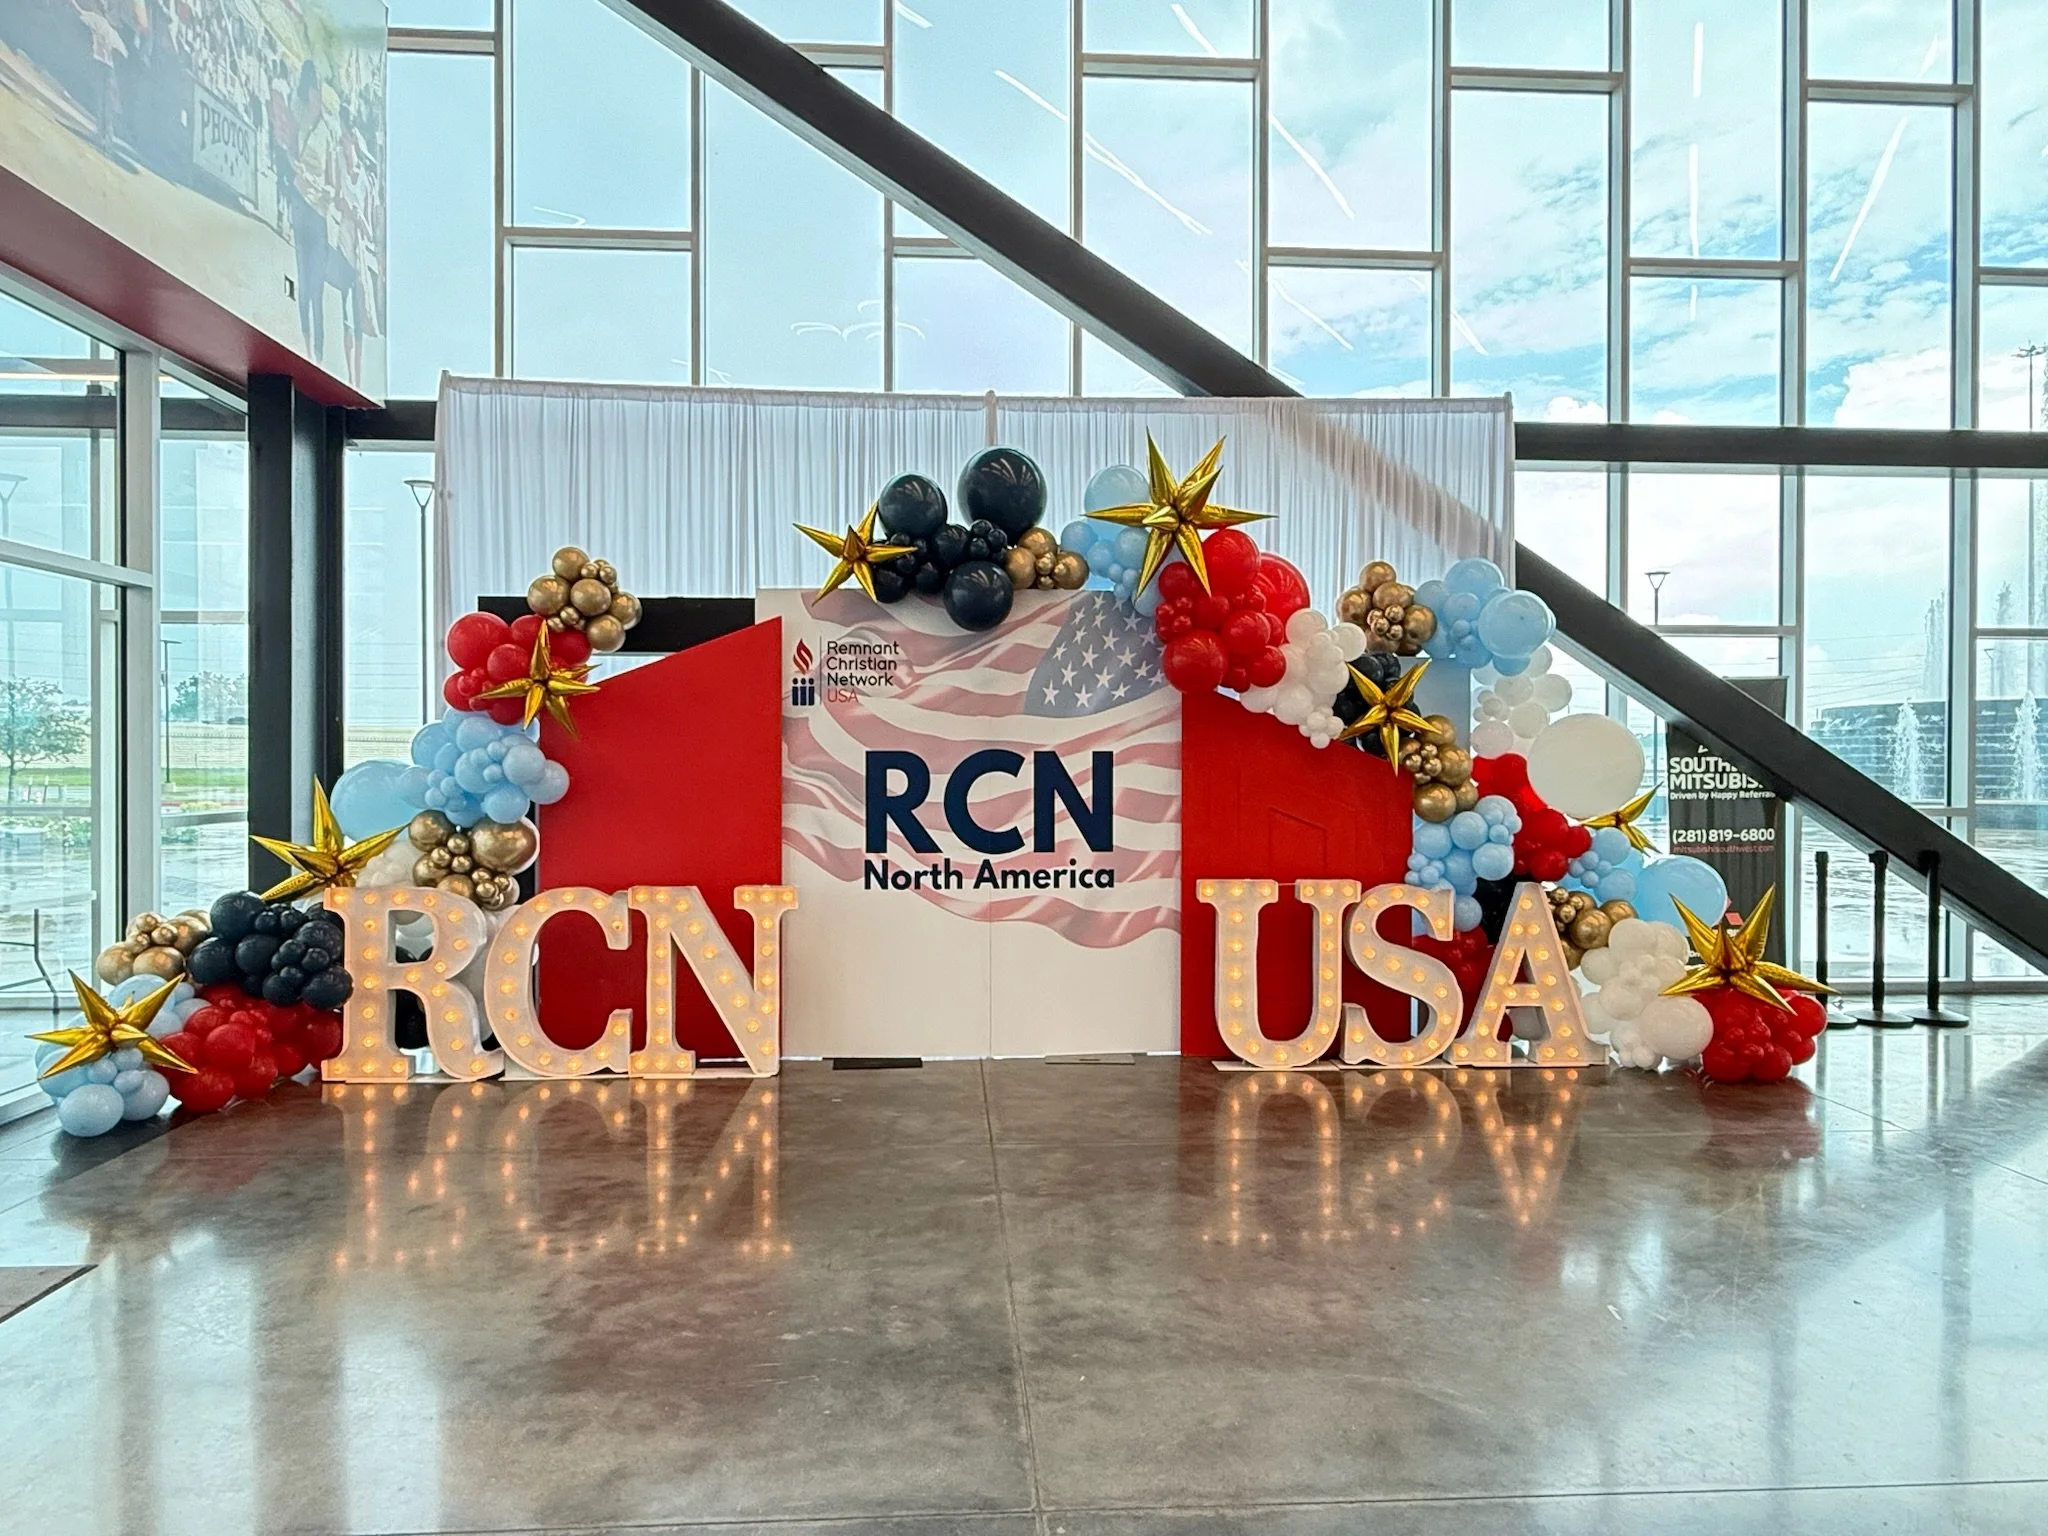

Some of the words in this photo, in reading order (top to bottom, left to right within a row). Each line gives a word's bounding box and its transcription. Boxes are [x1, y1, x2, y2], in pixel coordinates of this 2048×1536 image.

[200, 100, 250, 165] PHOTOS
[827, 641, 899, 655] Remnant
[826, 656, 897, 670] Christian
[827, 672, 894, 687] Network
[827, 689, 859, 703] USA
[1670, 757, 1738, 773] SOUTH
[1670, 773, 1764, 789] MITSUBIS
[865, 749, 1114, 854] RCN
[1670, 792, 1697, 800] Driven
[1698, 791, 1709, 800] by
[1710, 791, 1738, 800] Happy
[1672, 829, 1707, 844] (281)
[1708, 828, 1775, 842] 819-6800
[864, 858, 963, 890] North
[973, 859, 1115, 889] America
[1196, 879, 1610, 1068] USA
[321, 885, 799, 1082] RCN
